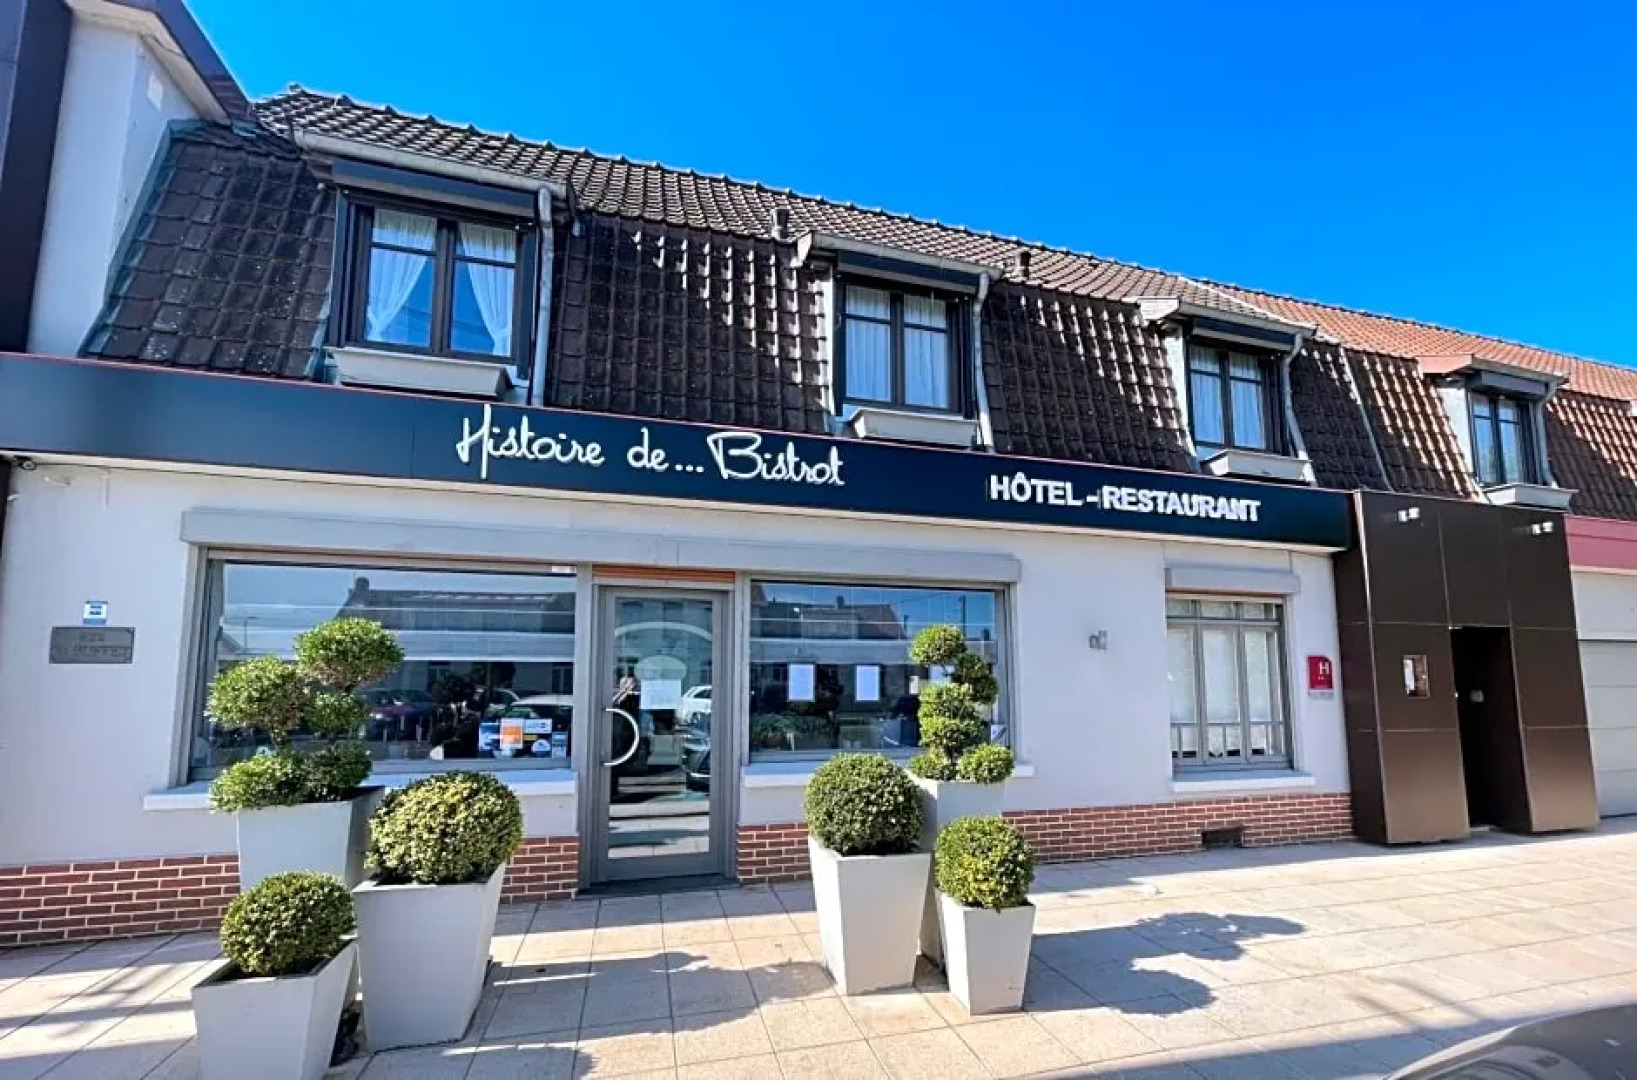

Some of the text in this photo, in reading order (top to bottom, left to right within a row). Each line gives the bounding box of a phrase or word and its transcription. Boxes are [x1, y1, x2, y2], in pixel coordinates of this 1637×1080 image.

[456, 403, 605, 480] Histoire
[707, 431, 846, 486] Bistrot
[990, 471, 1083, 506] HÔTEL
[1101, 485, 1261, 522] RESTAURANT
